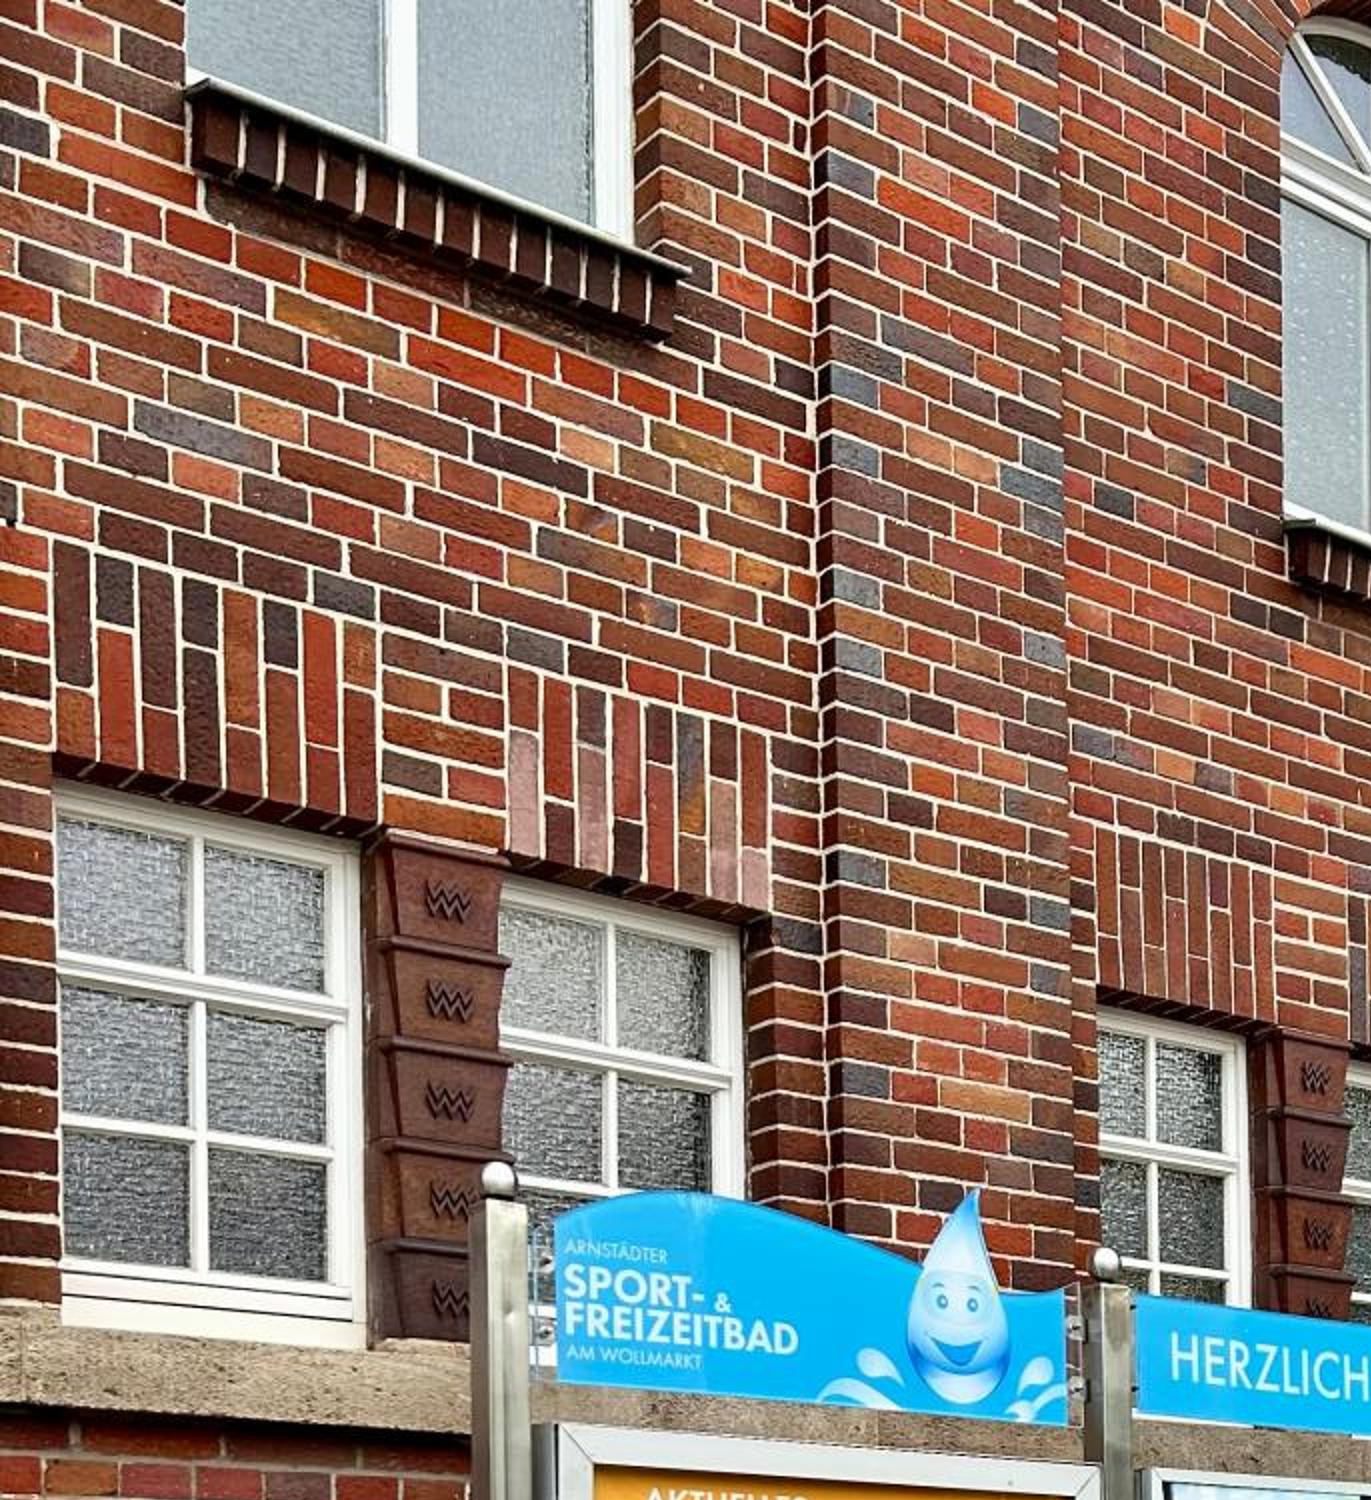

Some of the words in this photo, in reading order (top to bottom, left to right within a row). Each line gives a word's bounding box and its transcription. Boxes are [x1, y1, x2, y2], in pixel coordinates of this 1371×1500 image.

[563, 1238, 668, 1265] ARNSTÄDTER
[563, 1263, 705, 1309] SPORT-
[714, 1292, 732, 1313] &
[564, 1301, 799, 1356] FREIZEITBAD
[566, 1344, 596, 1360] AM
[600, 1347, 703, 1371] WOLLMARKT
[1169, 1331, 1371, 1401] HERZLICH
